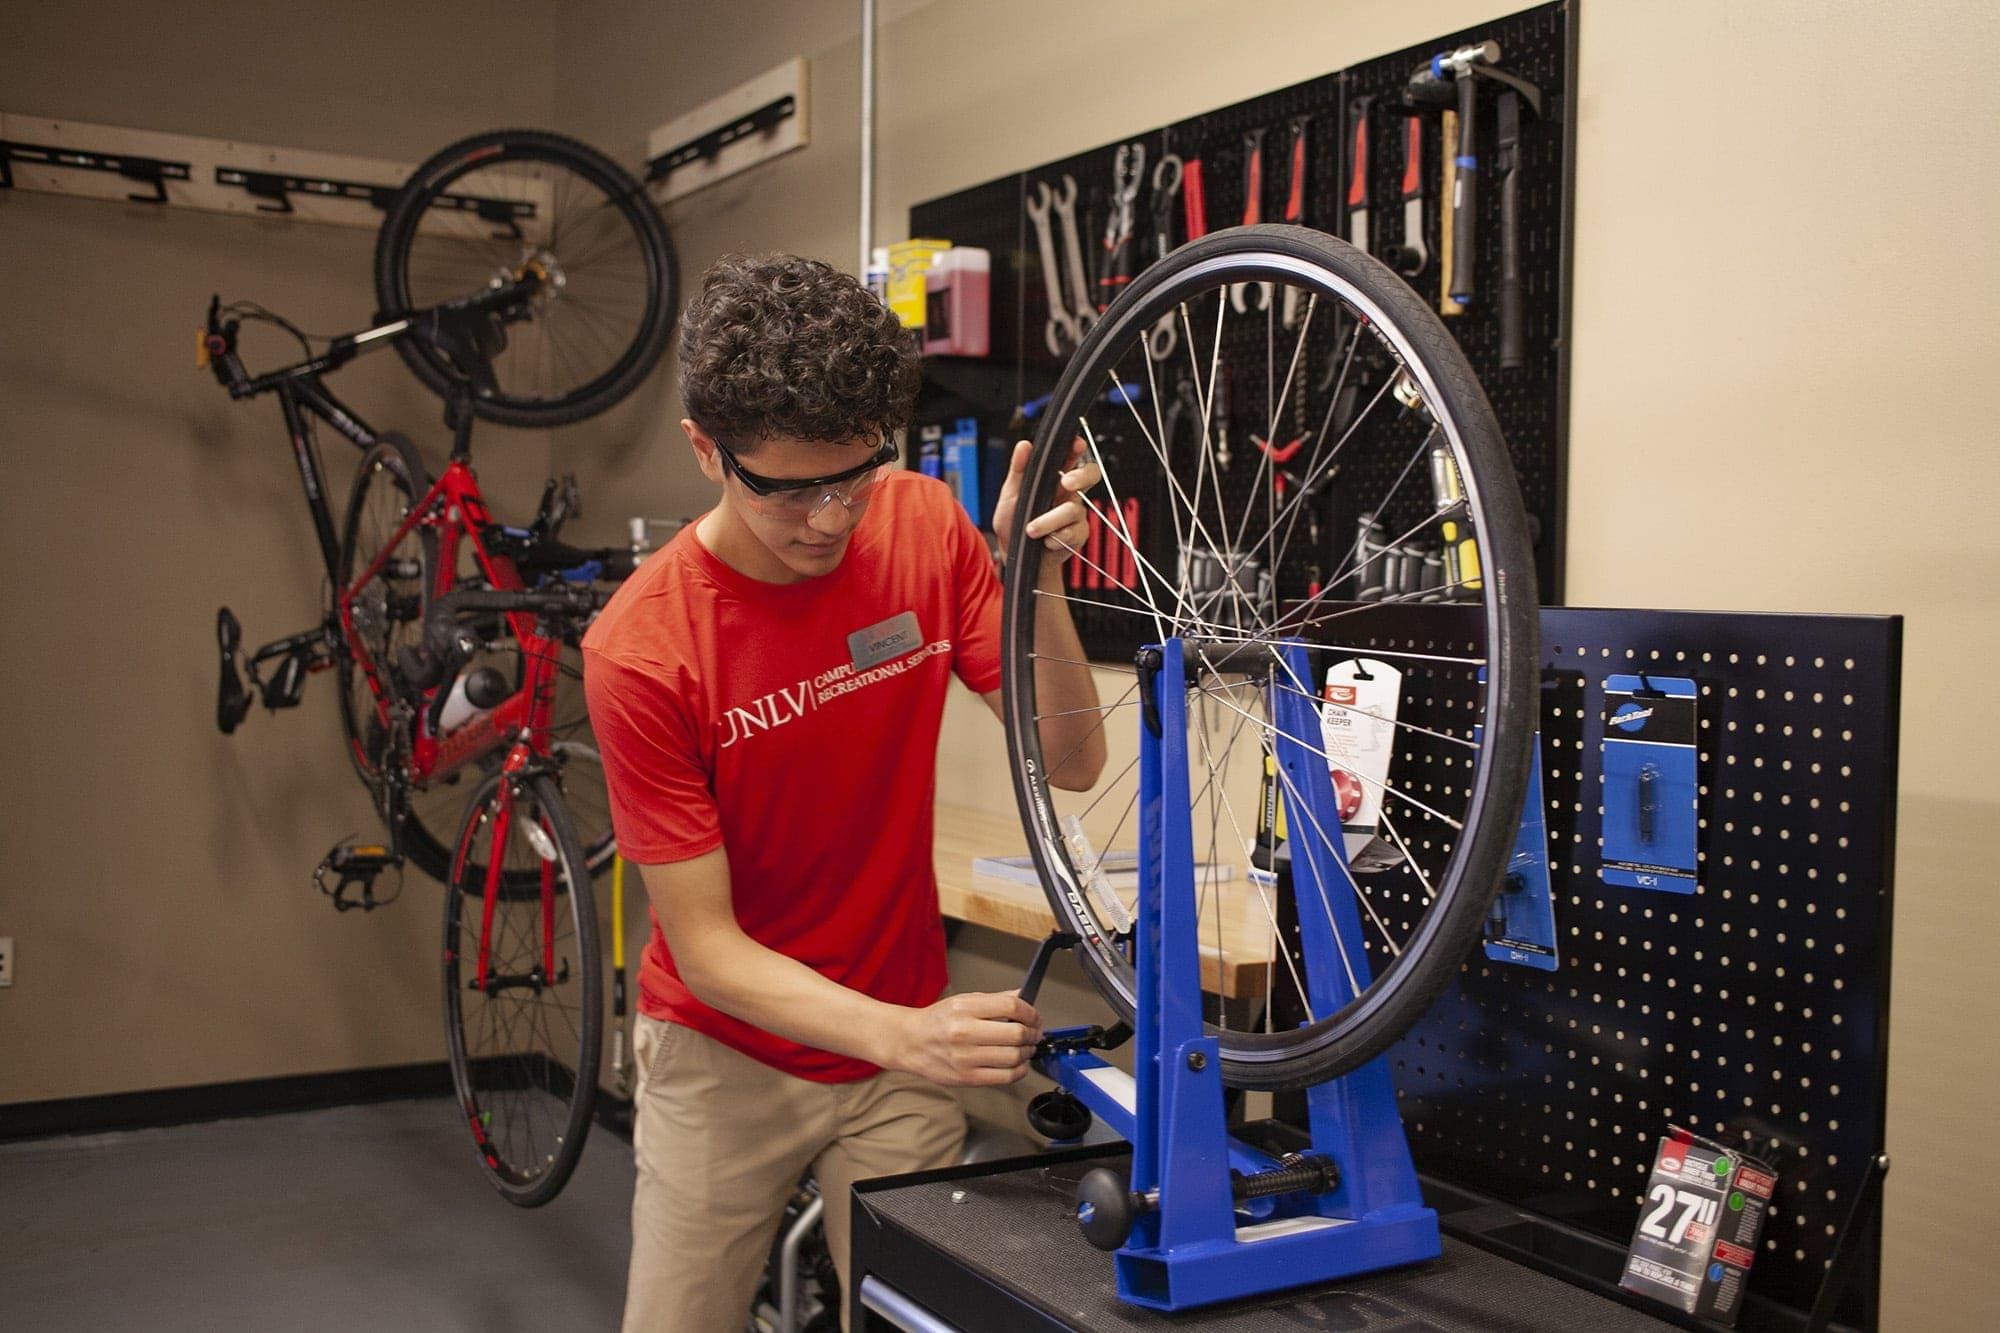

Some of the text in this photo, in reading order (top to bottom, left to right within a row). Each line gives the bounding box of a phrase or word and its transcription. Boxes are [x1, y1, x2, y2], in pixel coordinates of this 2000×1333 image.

[867, 629, 909, 652] VINCENT
[814, 661, 856, 689] CAMPU
[817, 660, 908, 704] RECREATIONAL
[1327, 708, 1348, 717] CHAIN
[1327, 717, 1352, 727] KEEPER
